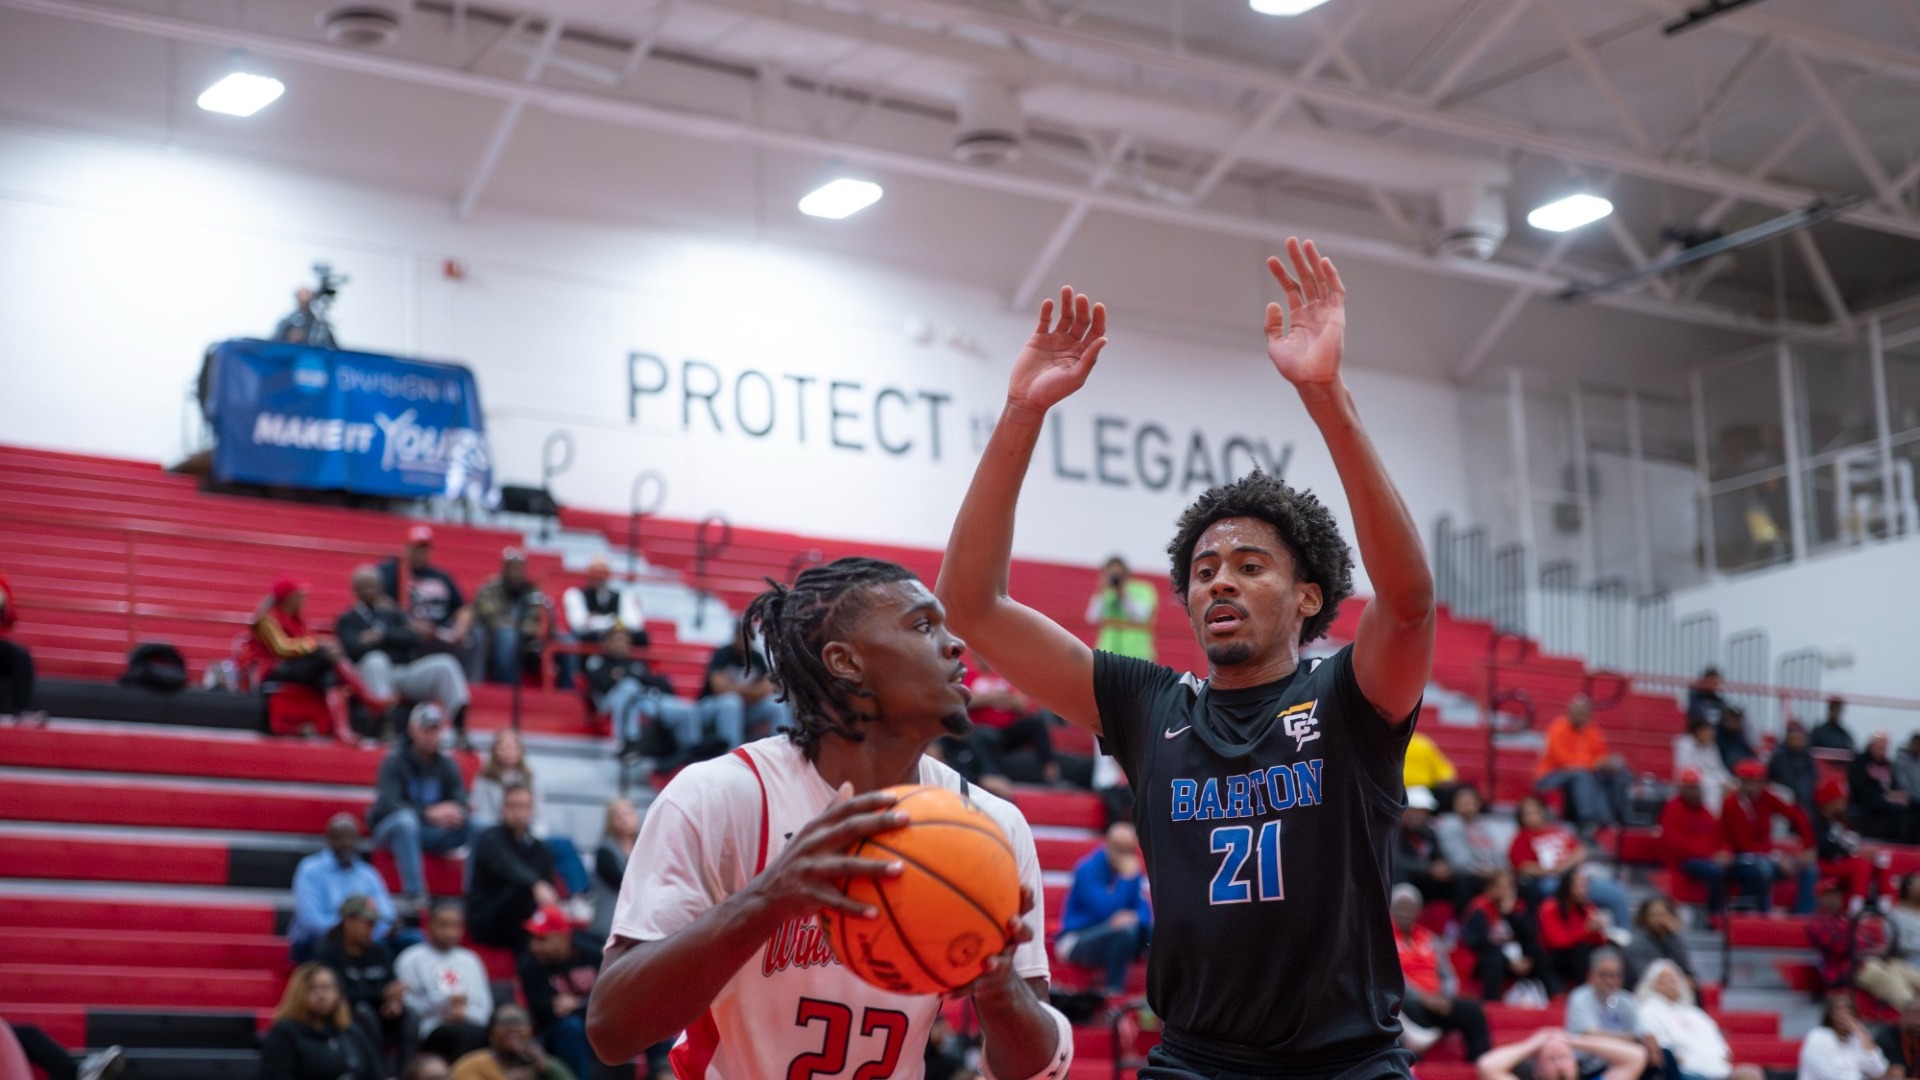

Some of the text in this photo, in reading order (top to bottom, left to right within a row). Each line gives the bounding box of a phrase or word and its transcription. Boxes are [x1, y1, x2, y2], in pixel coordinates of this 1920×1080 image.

[253, 412, 344, 451] MAKE
[626, 351, 951, 460] PROTECT
[1050, 410, 1294, 493] LEGACY
[1171, 758, 1324, 821] BARTON
[1209, 819, 1285, 905] 21
[786, 996, 909, 1080] 22
